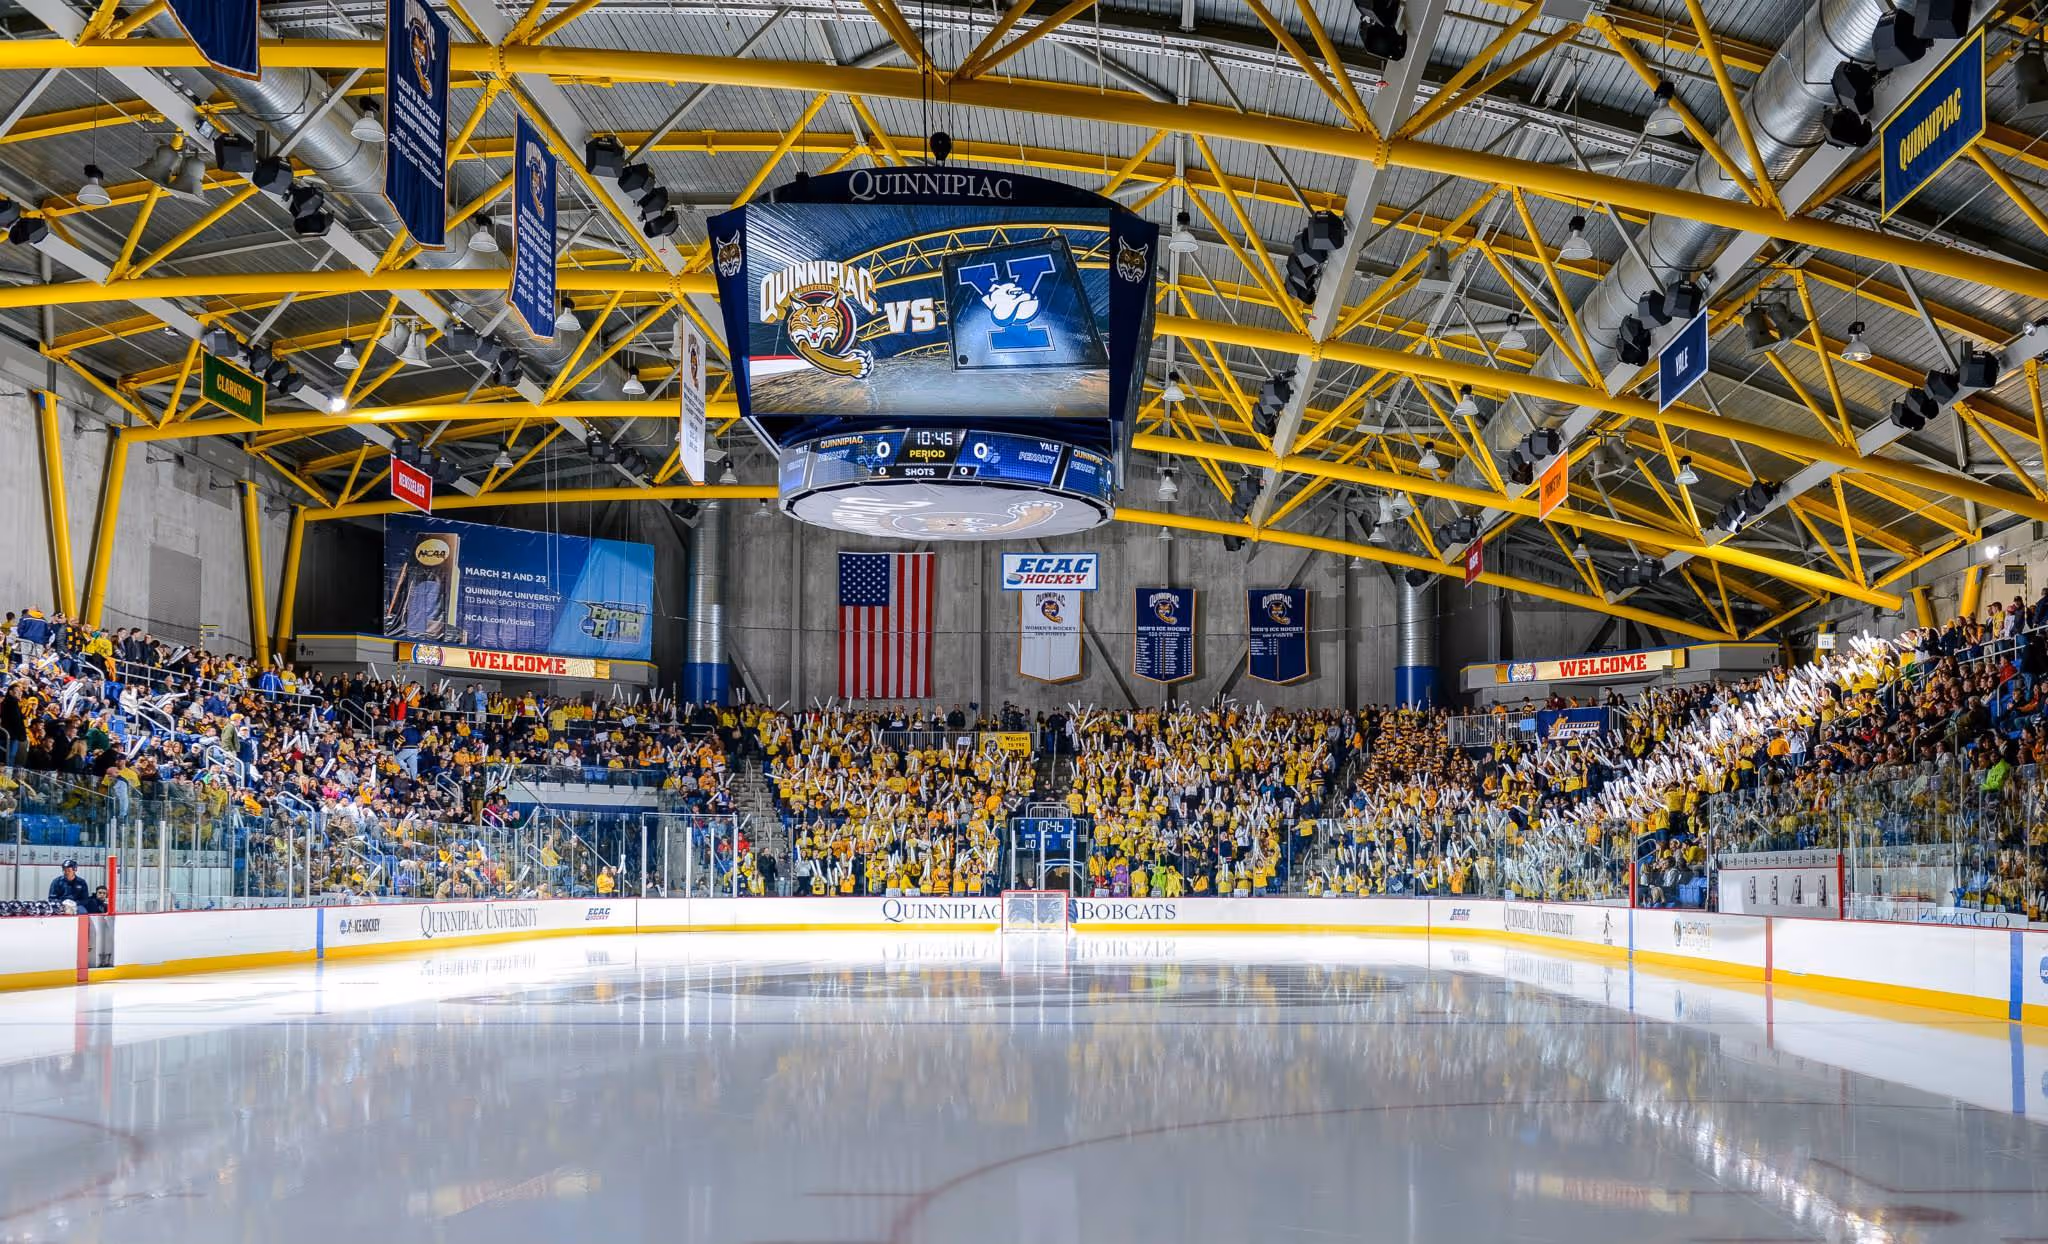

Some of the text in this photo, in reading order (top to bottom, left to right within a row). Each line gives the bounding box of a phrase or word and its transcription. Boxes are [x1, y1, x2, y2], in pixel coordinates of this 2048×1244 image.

[397, 90, 440, 140] TOURNAMENT
[394, 102, 442, 158] CHAMPIONSHIPS
[1899, 87, 1961, 172] QUINNIPIAC
[849, 169, 1013, 201] QUINNIPIAC
[760, 260, 881, 323] QUINNIPIAC
[884, 298, 937, 334] VS
[1675, 346, 1689, 377] YALE
[216, 373, 252, 407] CLARKSON
[820, 435, 864, 449] QUINNIPIAC
[917, 431, 953, 446] 10:46
[876, 441, 890, 458] 0
[909, 449, 946, 458] PERIOD
[973, 442, 987, 459] 0
[1039, 441, 1059, 453] YALE
[817, 449, 850, 463] PENALTY
[1018, 451, 1056, 464] PENALTY
[879, 466, 886, 475] 0
[904, 467, 935, 476] SHOTS
[960, 466, 968, 475] 0
[418, 549, 446, 558] NCAA
[1016, 558, 1094, 573] ECAC
[465, 567, 547, 583] MARCH 21 AND 23
[1023, 574, 1087, 585] HOCKEY
[465, 586, 562, 603] QUINNIPIAC UNIVERSITY
[476, 597, 497, 605] BANK
[499, 599, 526, 609] SPORTS
[527, 602, 555, 611] CENTER
[465, 614, 536, 627] NCAA.com/tickets
[468, 650, 567, 675] WELCOME
[1559, 654, 1648, 678] WELCOME
[1038, 820, 1064, 833] 10:46
[588, 907, 611, 915] ECAC
[882, 899, 1177, 923] QUINNIPIAC BOBCATS
[1452, 908, 1471, 916] ECAC
[362, 918, 380, 933] HOCKEY
[420, 903, 538, 939] QUINNIPIAC UNIVERSITY
[1503, 902, 1575, 936] QUINNIPIAC UNIVERSITY
